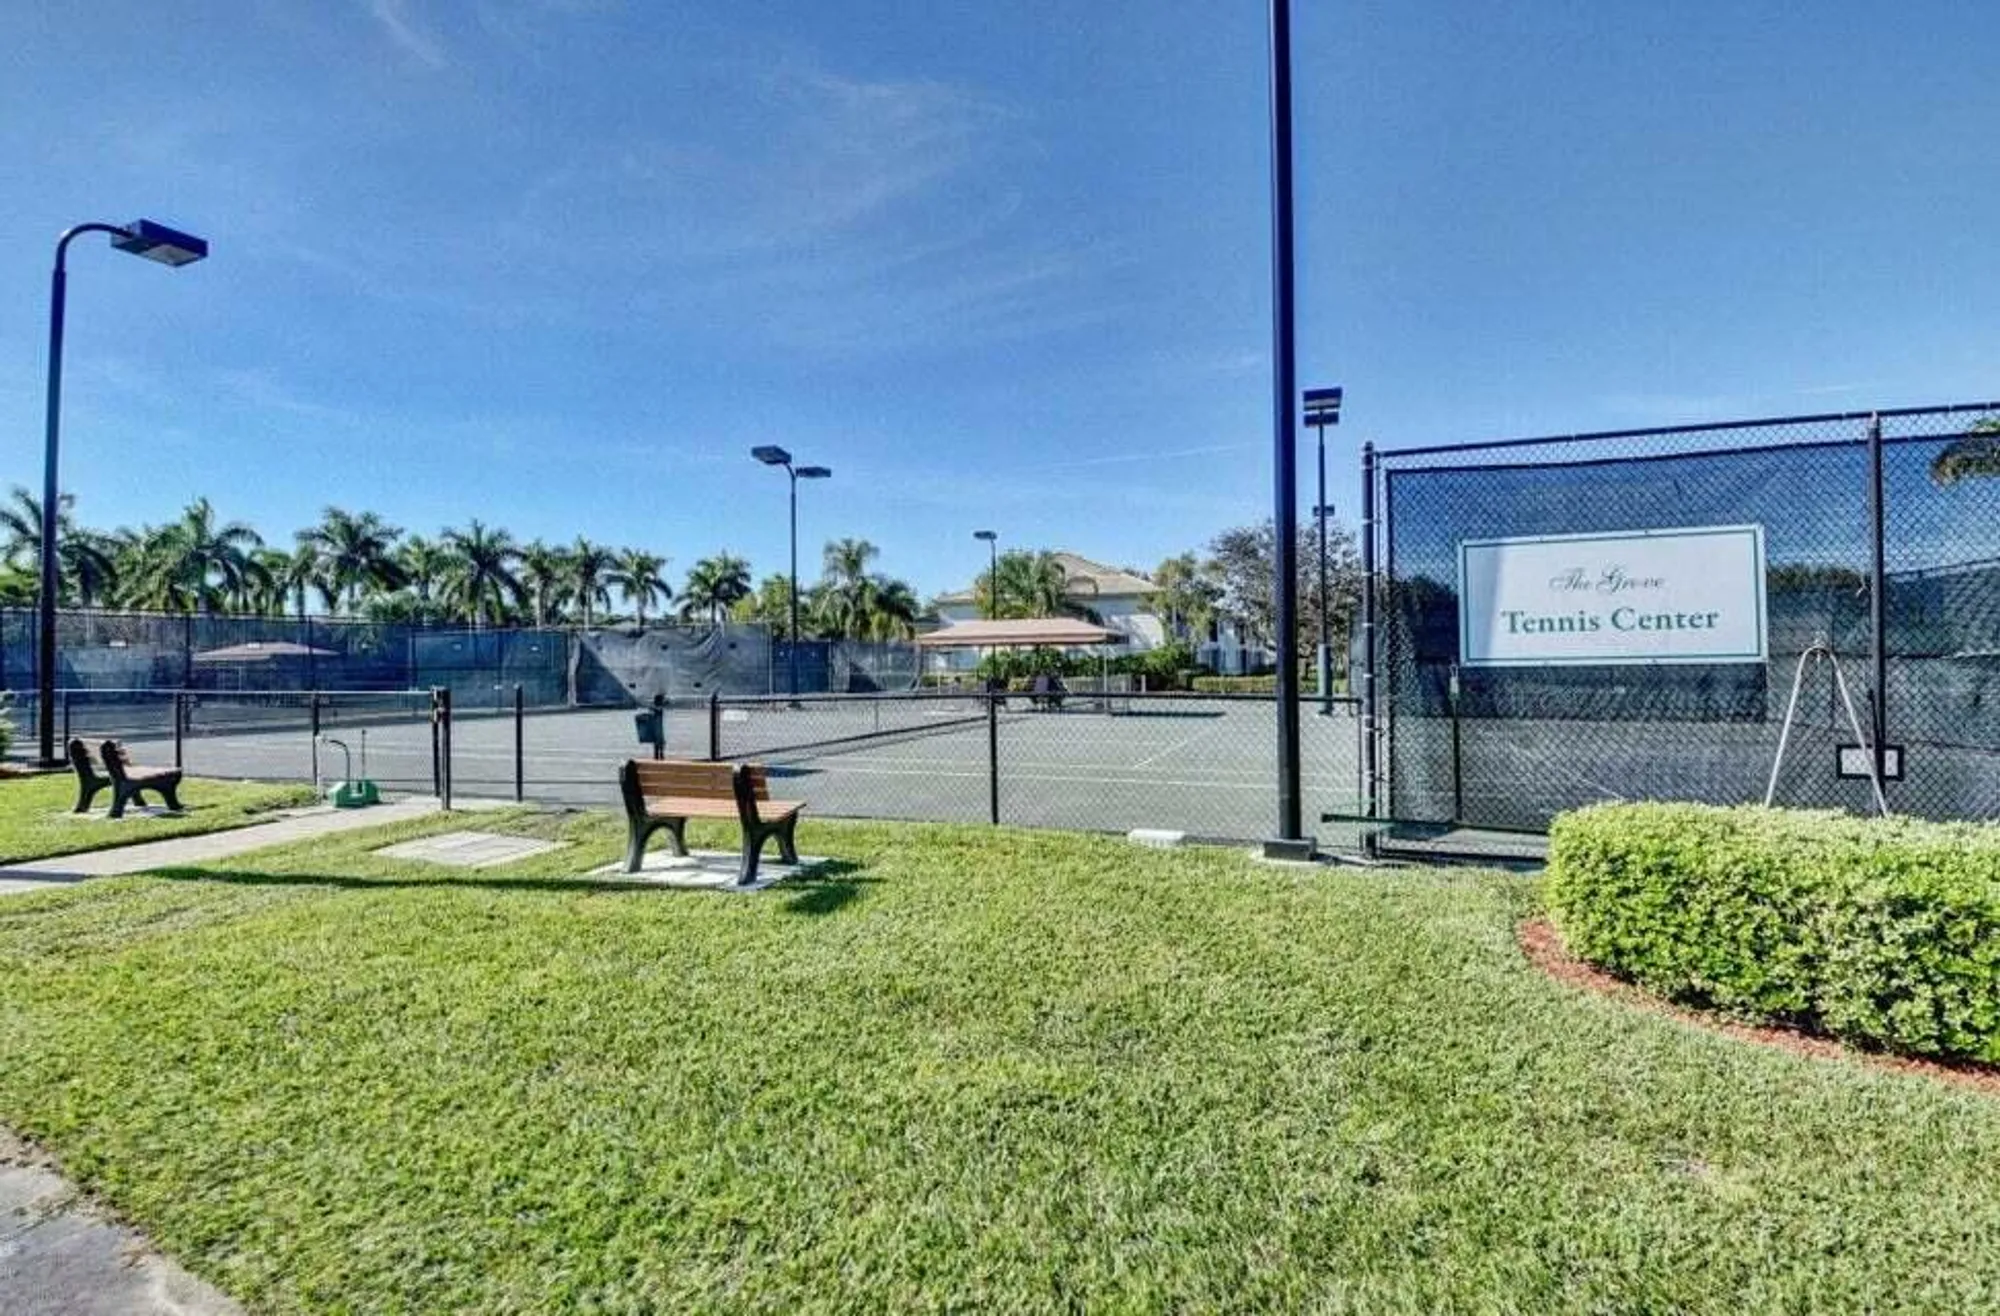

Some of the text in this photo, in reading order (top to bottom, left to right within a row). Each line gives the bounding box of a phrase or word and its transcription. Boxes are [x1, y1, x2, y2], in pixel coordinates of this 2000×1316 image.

[1550, 565, 1664, 594] The Grove
[1502, 607, 1719, 634] Tennis Center
